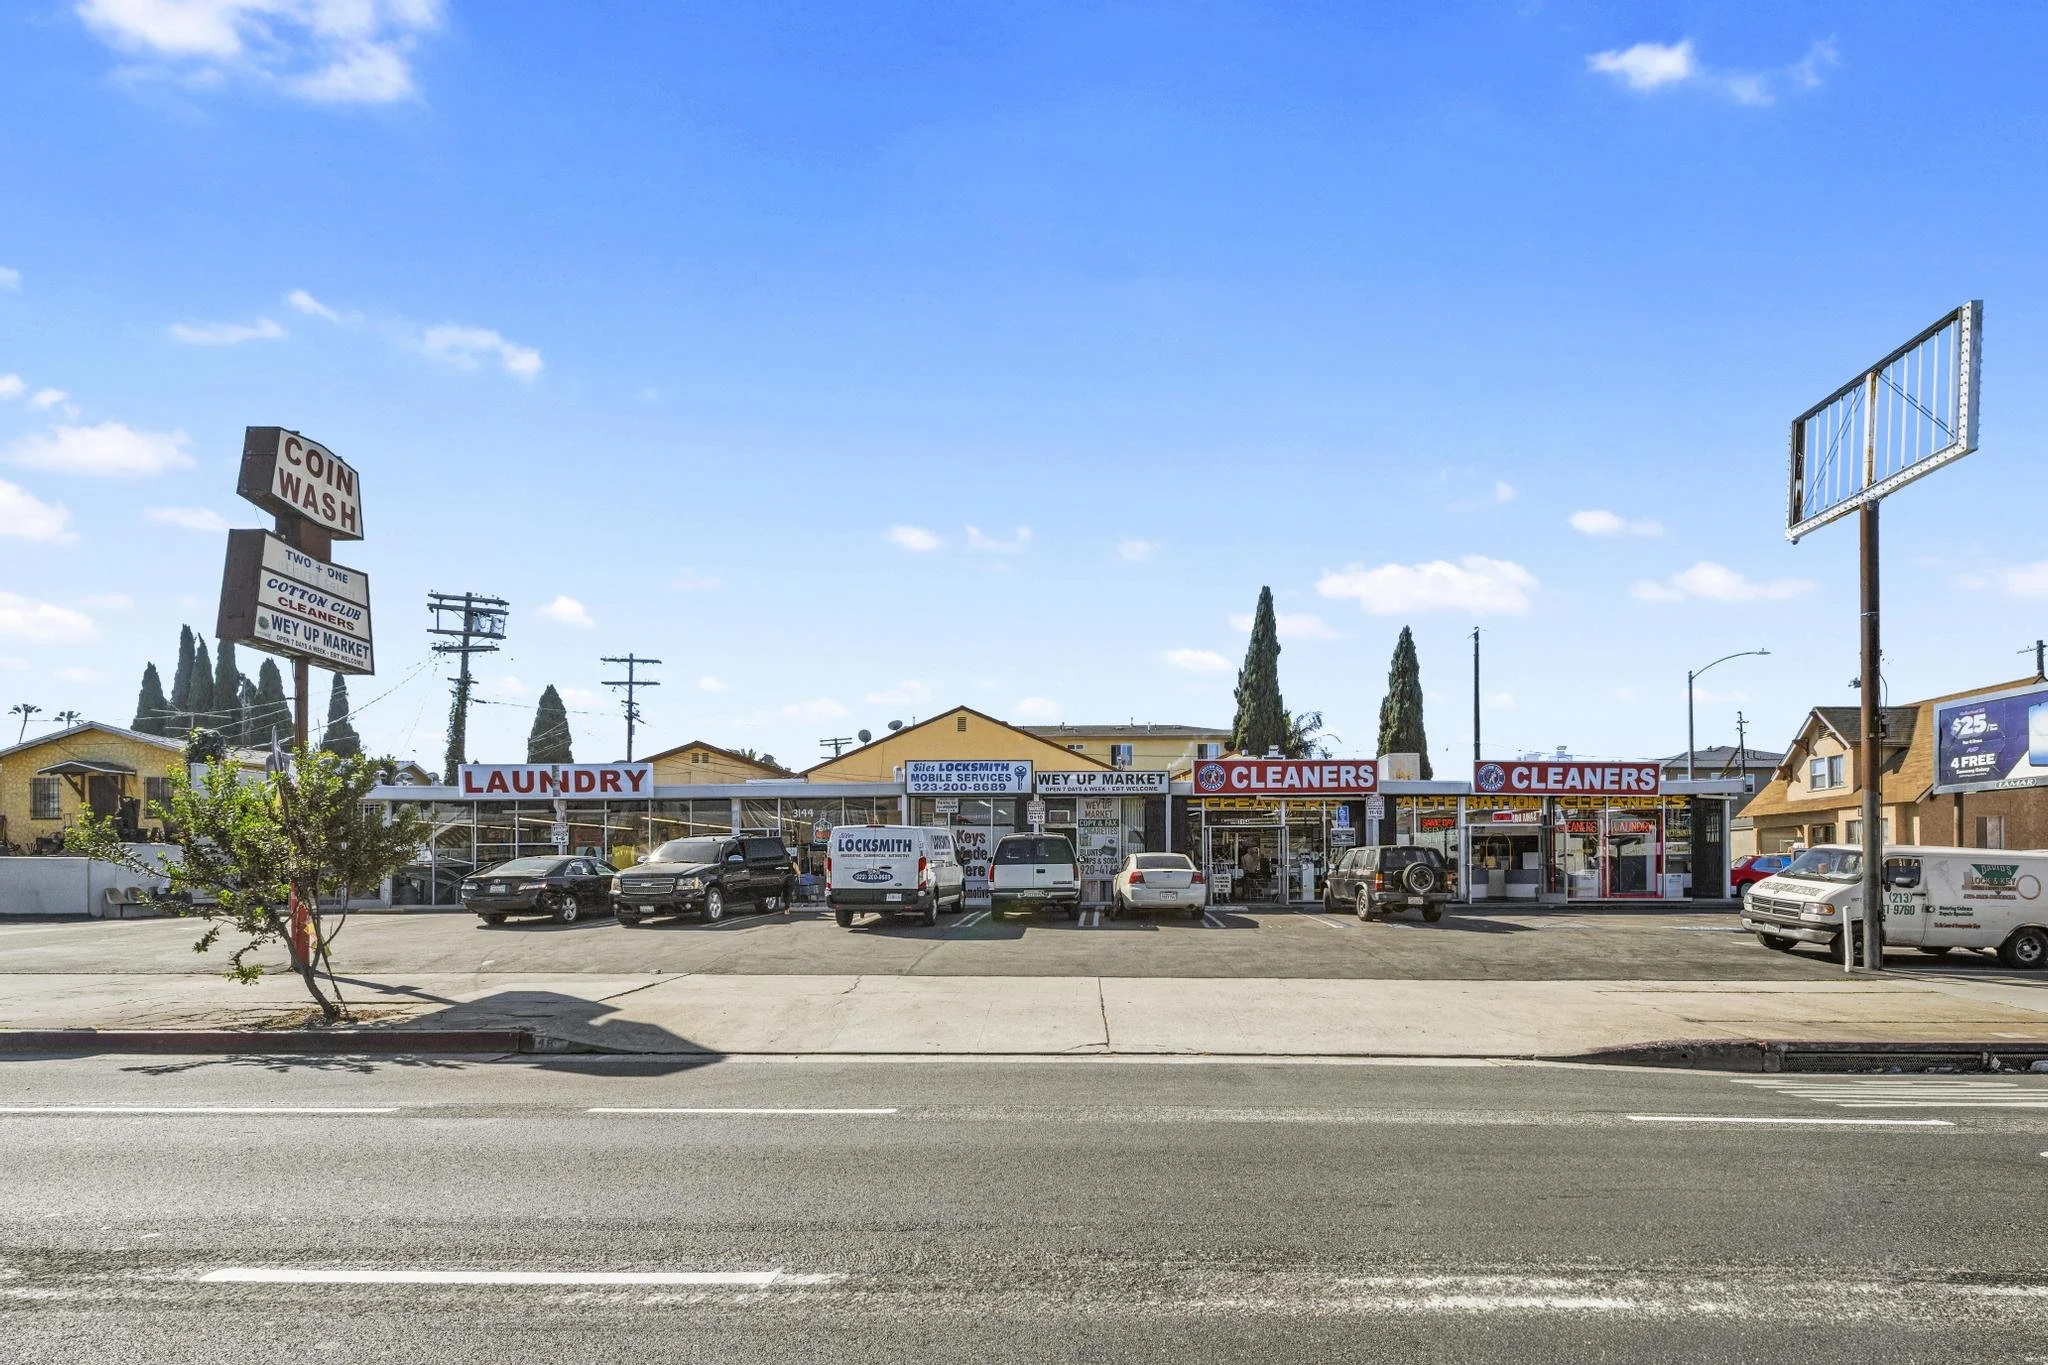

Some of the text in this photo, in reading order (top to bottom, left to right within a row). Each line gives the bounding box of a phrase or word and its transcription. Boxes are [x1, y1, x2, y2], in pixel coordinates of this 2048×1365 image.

[284, 436, 353, 497] COIN
[278, 466, 356, 533] WASH
[286, 549, 311, 568] TWO
[327, 567, 348, 584] ONE
[267, 578, 328, 607] COTTON
[331, 602, 362, 621] CLUB
[278, 596, 354, 631] CLEANERS
[271, 614, 369, 660] WEY UP MARKET
[276, 634, 289, 644] OPEN
[1951, 713, 1987, 737] $25
[1950, 753, 1996, 768] 4 FREE
[913, 763, 1010, 772] Siles LOCKSMITH
[464, 769, 648, 793] LAUNDRY
[910, 773, 1012, 782] MOBILE SERVICES
[1037, 773, 1166, 785] WEY UP MARKET
[1231, 765, 1374, 789] CLEANERS
[1511, 767, 1656, 791] CLEANERS
[1998, 779, 2033, 787] LAMAR
[914, 783, 1006, 791] 323-200-8689
[1086, 800, 1112, 809] WEY UP
[1205, 797, 1342, 810] CLEANERS
[1560, 796, 1687, 808] CLEANERS
[792, 809, 814, 818] 3144
[1085, 810, 1112, 818] MARKET
[1612, 821, 1653, 833] LAUNDRY
[956, 829, 986, 847] Keys
[838, 839, 912, 853] LOCKSMITH
[965, 865, 986, 877] ere
[1981, 864, 2012, 876] DAVID'S
[2000, 877, 2016, 885] KEY
[1889, 891, 1912, 903] (213)
